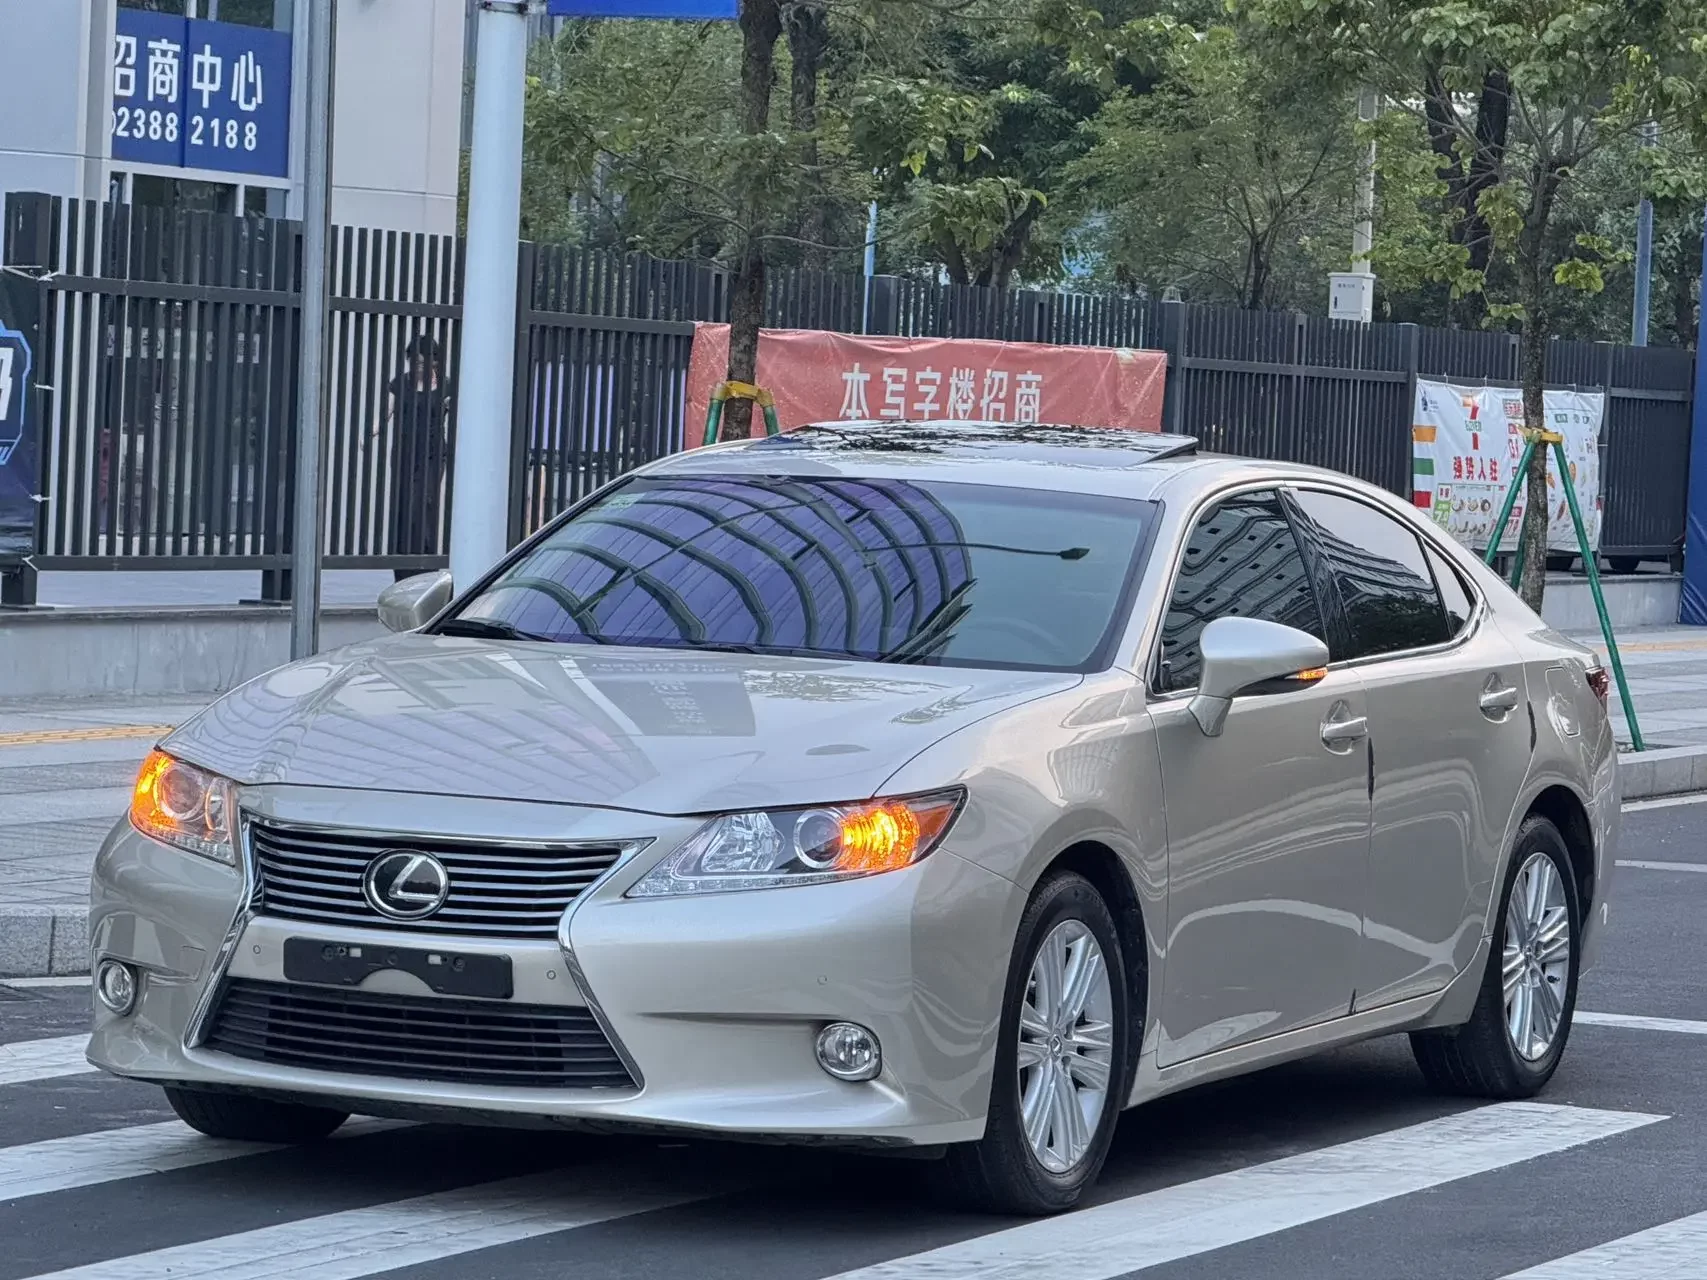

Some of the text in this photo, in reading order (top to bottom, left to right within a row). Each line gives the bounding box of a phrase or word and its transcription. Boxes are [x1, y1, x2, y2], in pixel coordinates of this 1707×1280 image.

[190, 115, 257, 151] 2188
[838, 362, 1043, 422] 本写字楼招商
